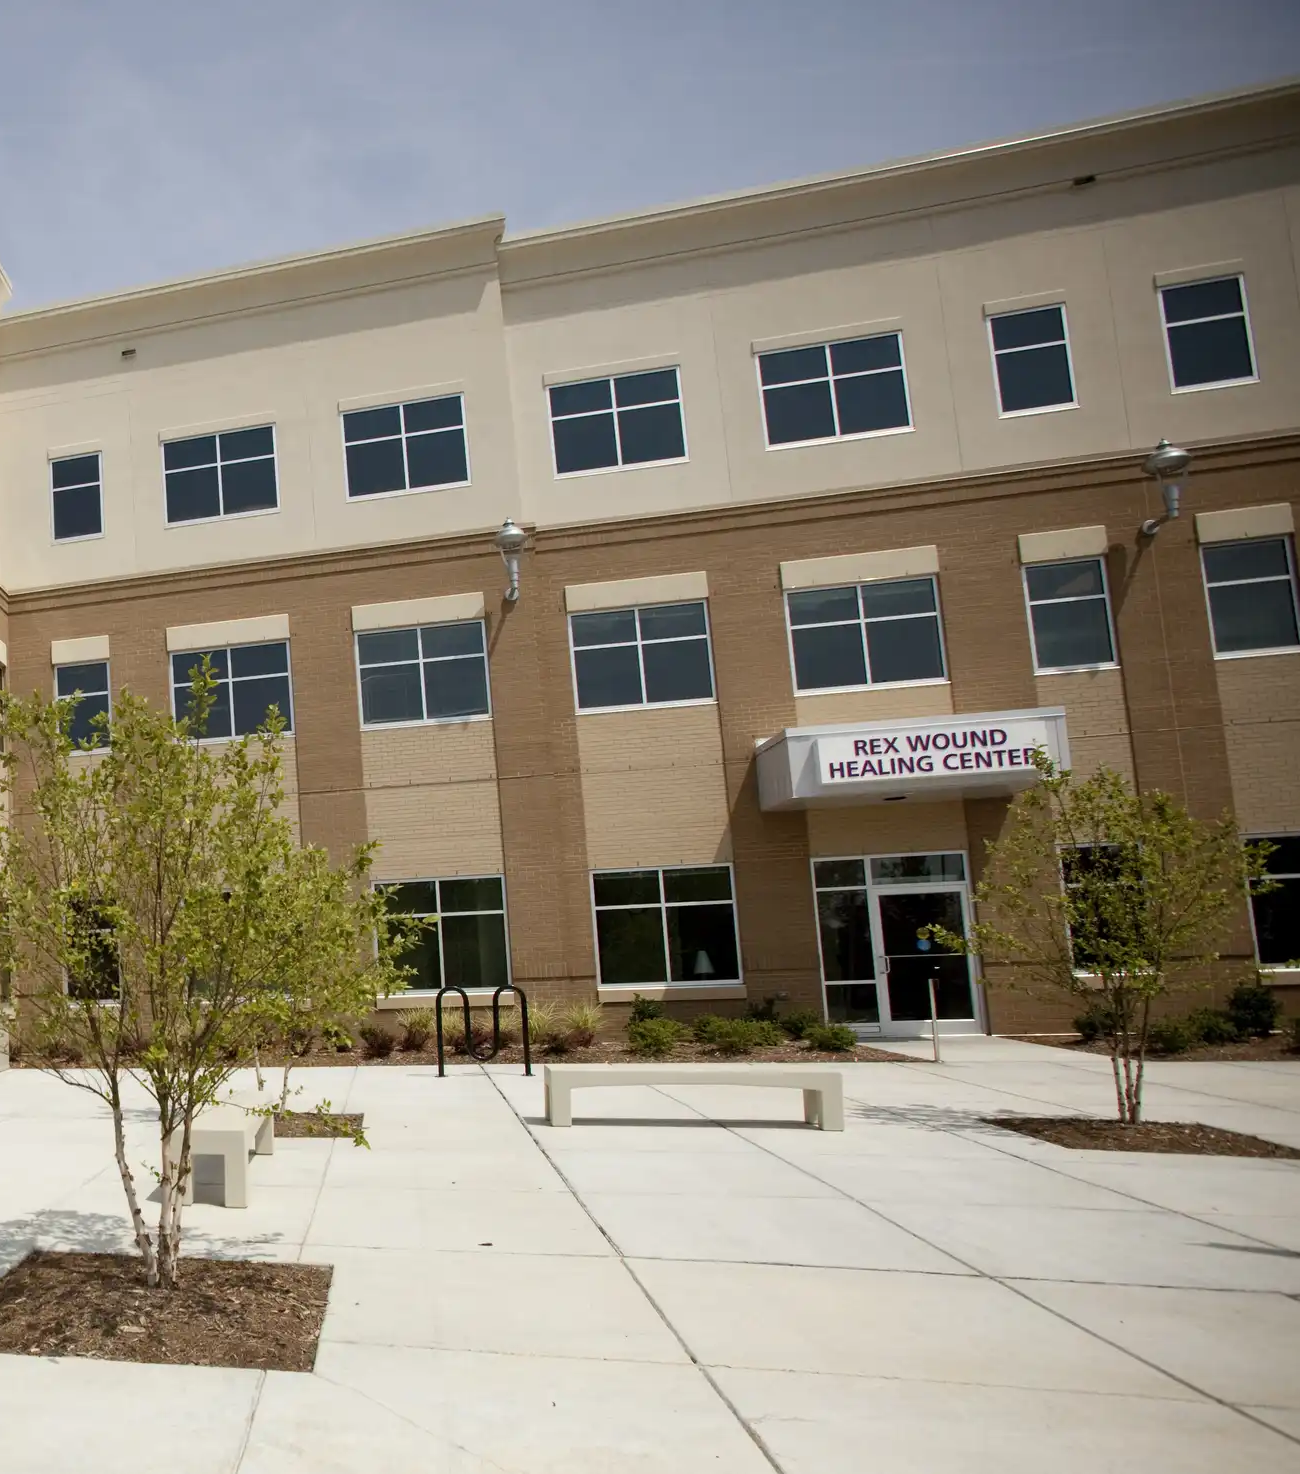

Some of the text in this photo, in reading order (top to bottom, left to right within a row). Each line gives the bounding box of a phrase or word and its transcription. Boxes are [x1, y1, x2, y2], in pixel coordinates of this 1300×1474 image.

[853, 728, 1007, 757] REX WOUND
[828, 755, 934, 779] HEALING
